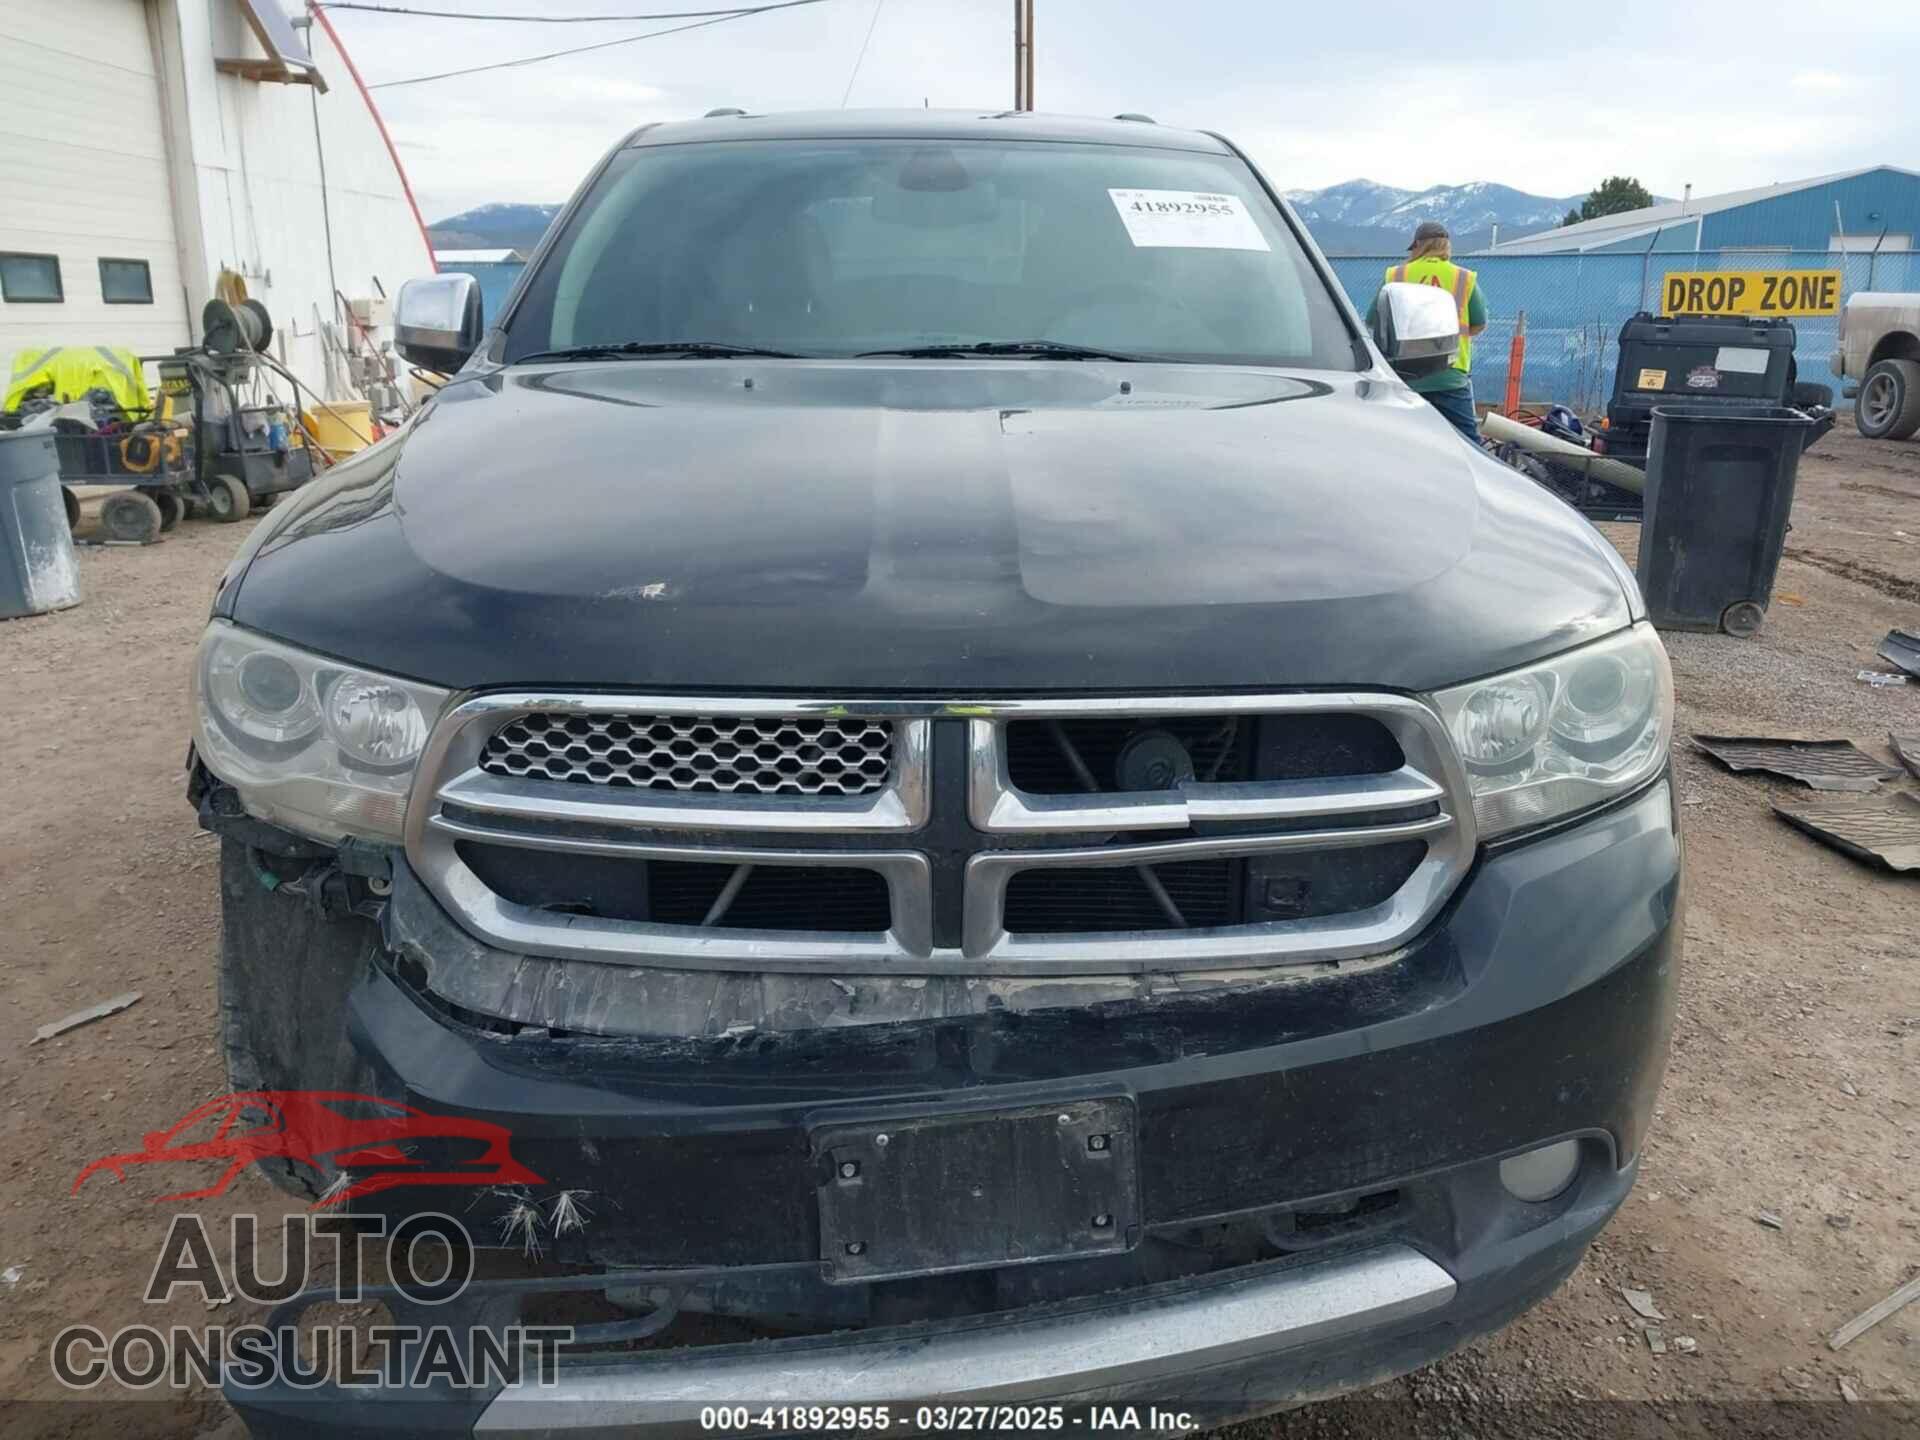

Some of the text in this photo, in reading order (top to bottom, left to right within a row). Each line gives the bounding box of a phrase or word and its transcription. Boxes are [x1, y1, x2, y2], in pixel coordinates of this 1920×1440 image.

[1130, 201, 1234, 216] 41892955
[1667, 276, 1836, 312] DROP ZONE
